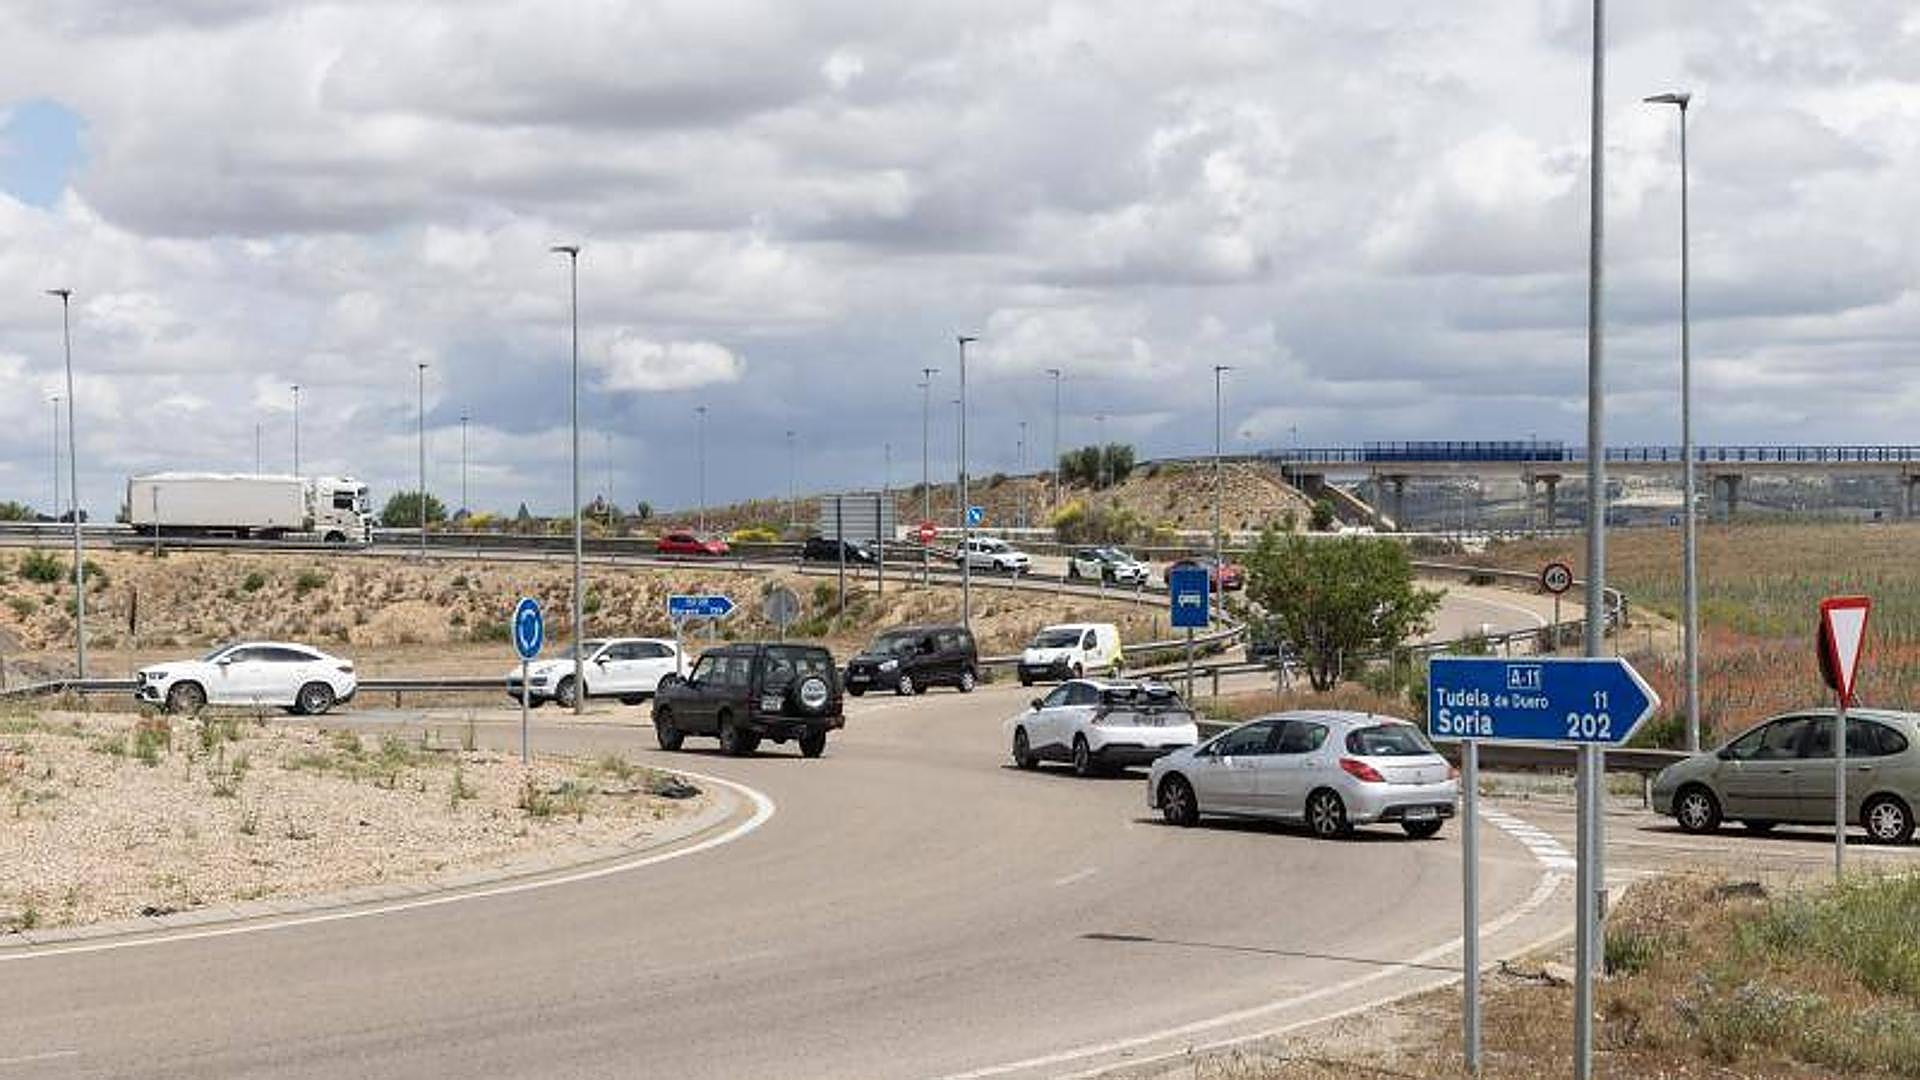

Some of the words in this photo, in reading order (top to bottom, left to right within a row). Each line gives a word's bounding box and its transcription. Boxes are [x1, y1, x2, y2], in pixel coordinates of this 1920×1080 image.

[1548, 572, 1566, 584] 40
[1511, 669, 1540, 686] A-11
[1437, 688, 1489, 707] Tudela
[1494, 694, 1508, 708] de
[1511, 693, 1549, 709] Duero
[1593, 690, 1608, 709] 11
[1437, 708, 1493, 735] Soria
[1566, 712, 1611, 738] 202
